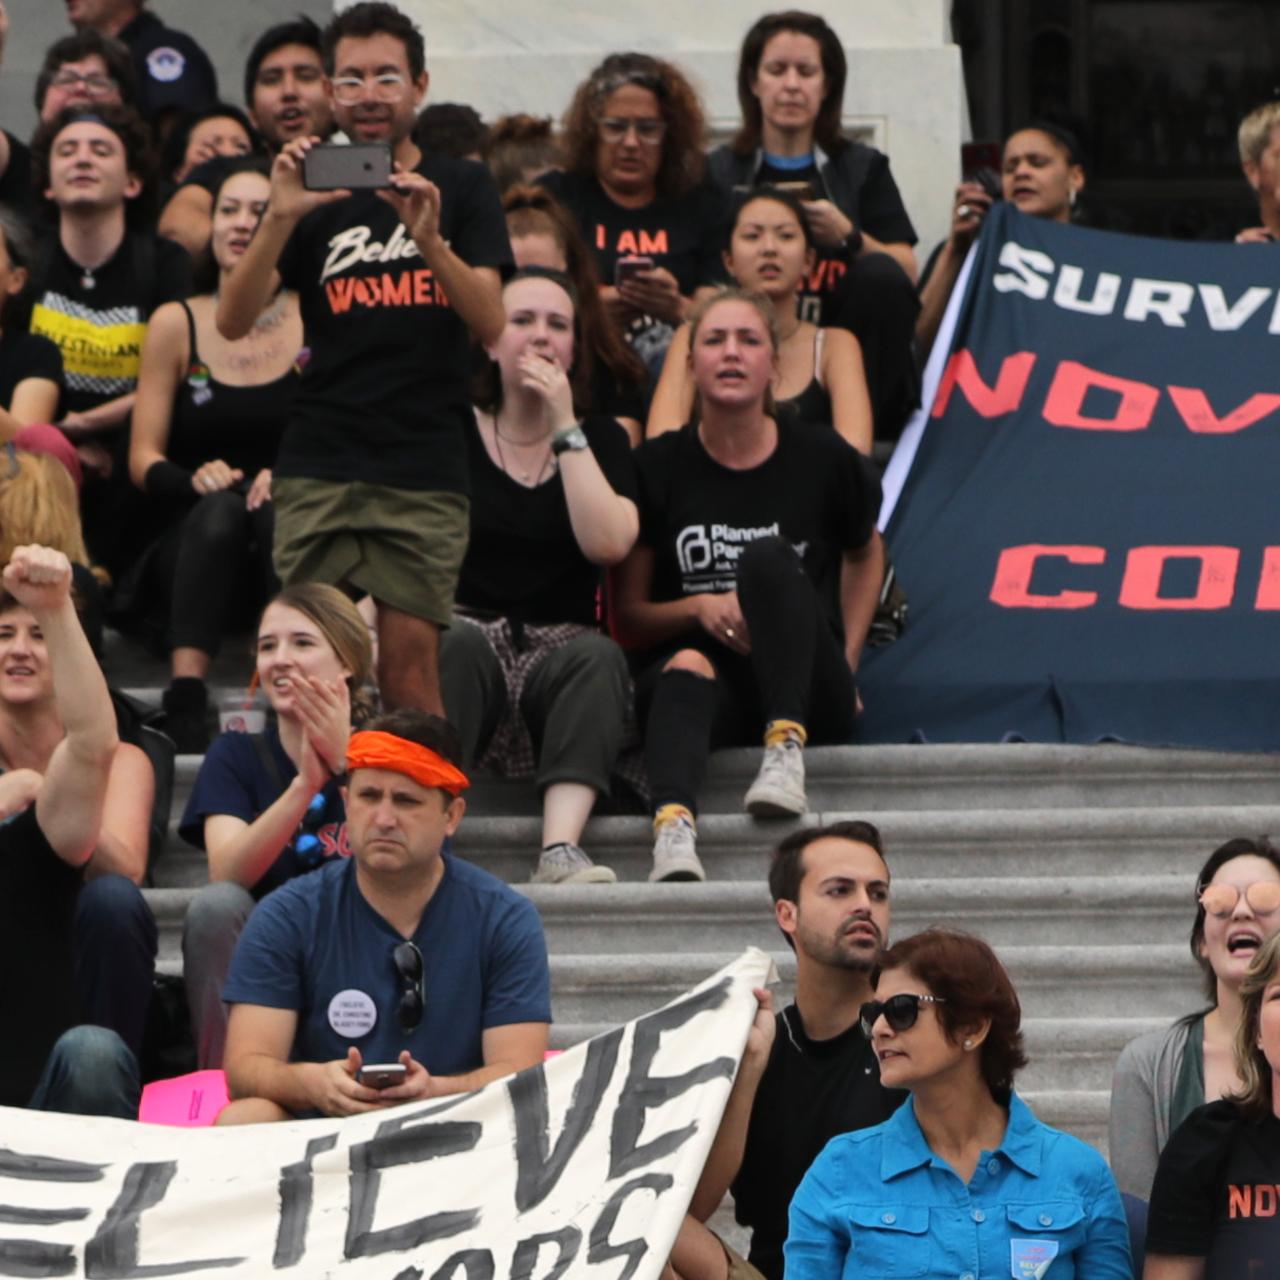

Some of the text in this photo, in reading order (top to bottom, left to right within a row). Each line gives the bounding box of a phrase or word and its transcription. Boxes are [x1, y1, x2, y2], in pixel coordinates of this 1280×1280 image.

[319, 222, 451, 285] Belie
[596, 223, 669, 254] I AM
[711, 521, 780, 542] Planned
